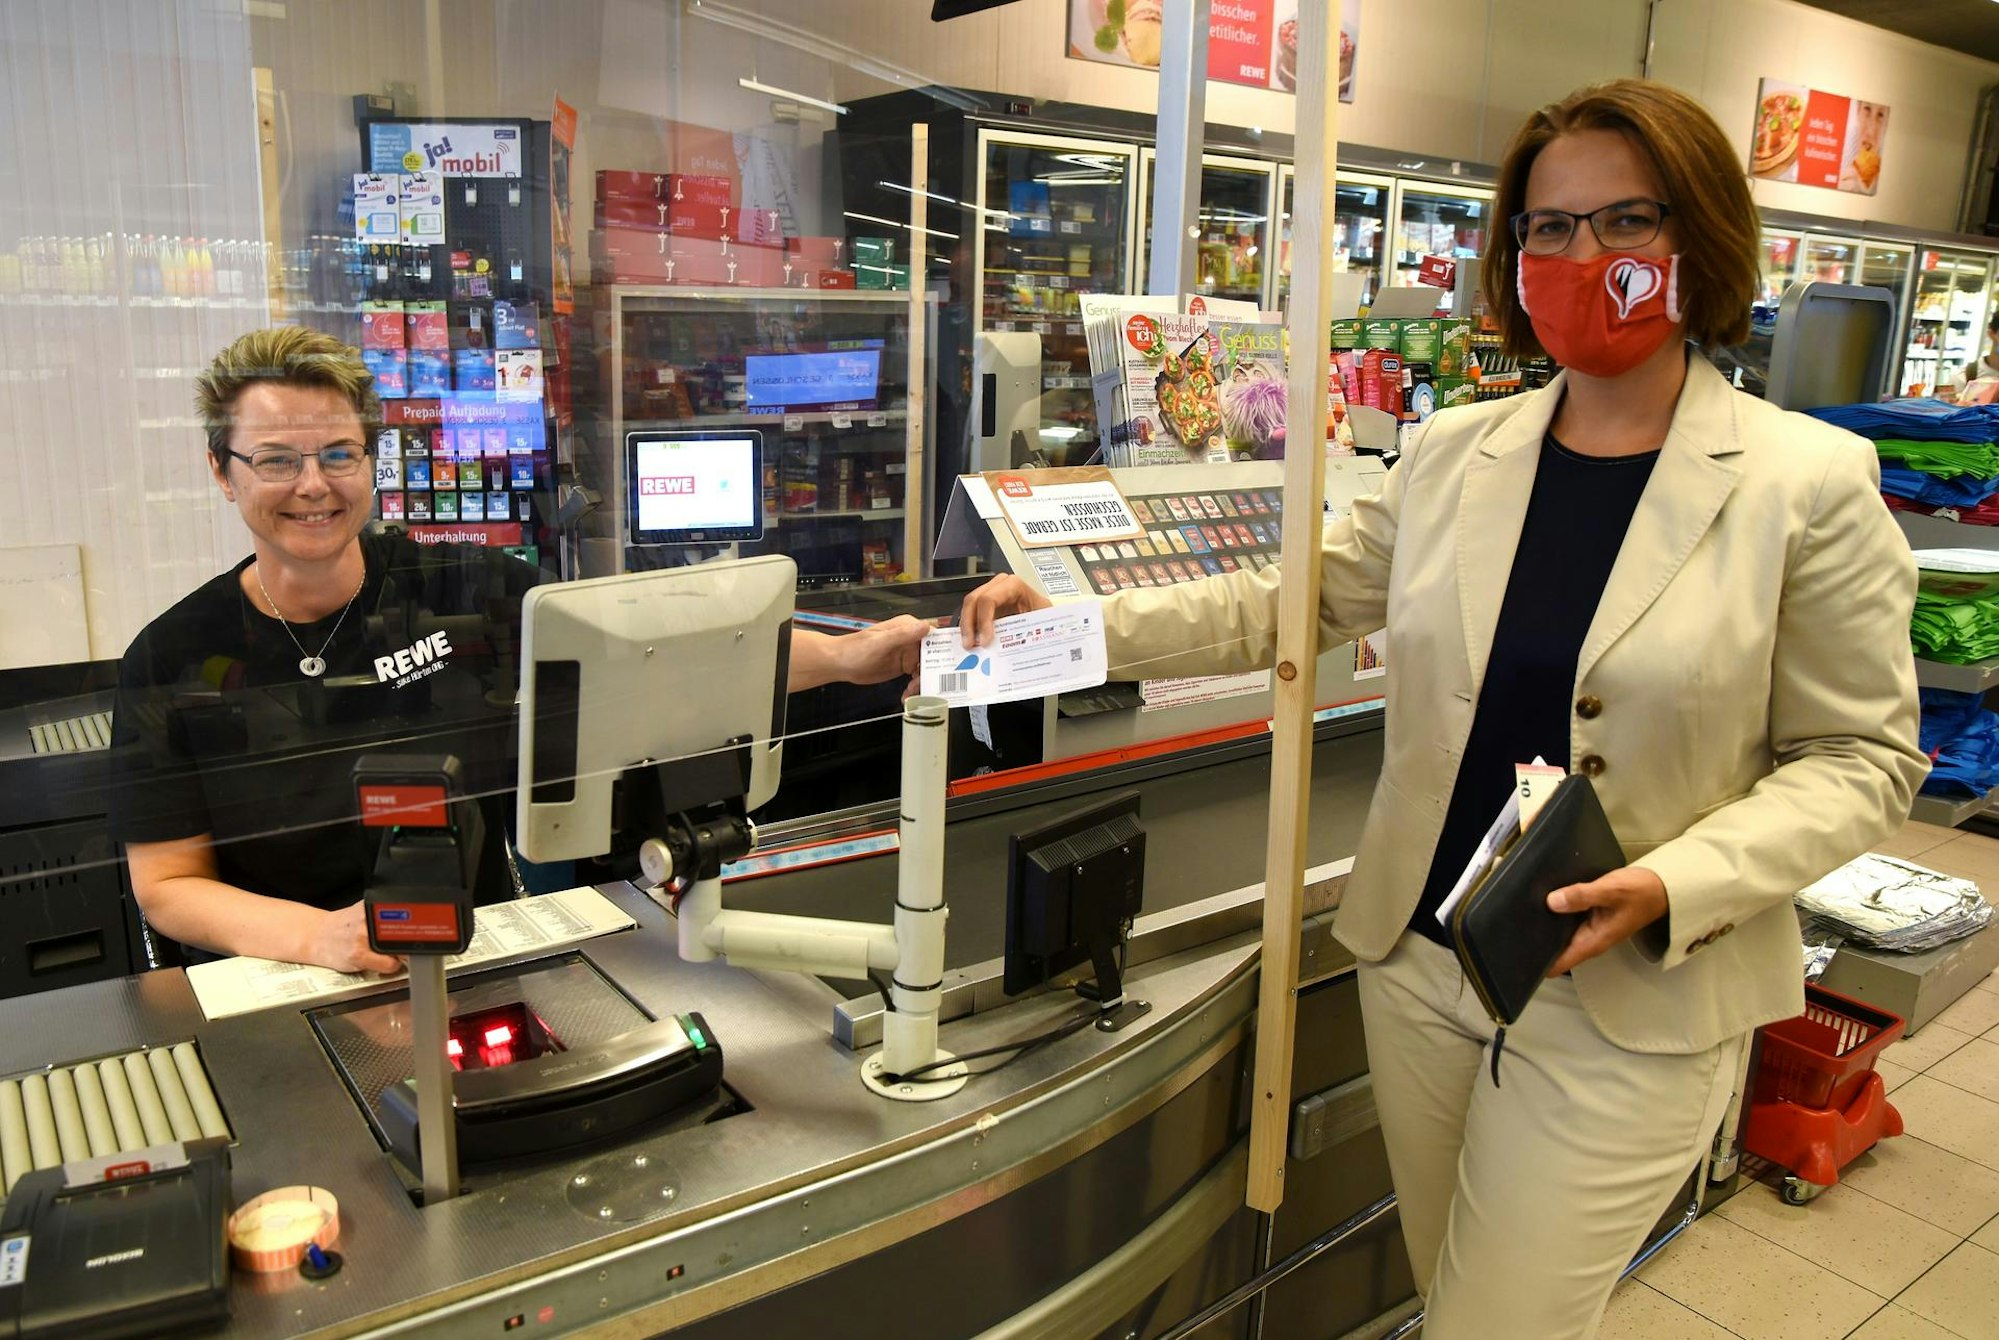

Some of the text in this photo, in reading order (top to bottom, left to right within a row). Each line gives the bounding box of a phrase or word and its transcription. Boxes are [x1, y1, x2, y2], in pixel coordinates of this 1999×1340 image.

[1211, 1, 1256, 22] bisschen
[1240, 65, 1265, 80] REWE
[424, 136, 453, 168] ja!
[442, 152, 501, 173] mobil
[364, 184, 385, 192] mobil
[409, 184, 431, 193] mobil
[497, 308, 507, 325] 3
[1136, 326, 1153, 342] ich
[1160, 315, 1206, 337] Herzhaftes
[1179, 335, 1193, 343] Blech
[1220, 325, 1278, 351] Genuss
[403, 406, 445, 420] Prepaid
[1139, 449, 1185, 459] Einmachzeit
[377, 467, 399, 480] 30,-
[642, 478, 693, 494] REWE
[1060, 500, 1122, 516] GESCHLOSSEN.
[1021, 514, 1131, 535] DIESE KASSE IST GERADE
[414, 530, 487, 544] Unterhaltung
[1002, 641, 1020, 649] toom
[374, 630, 453, 683] REWE
[1520, 778, 1531, 798] 10
[366, 796, 397, 805] REWE
